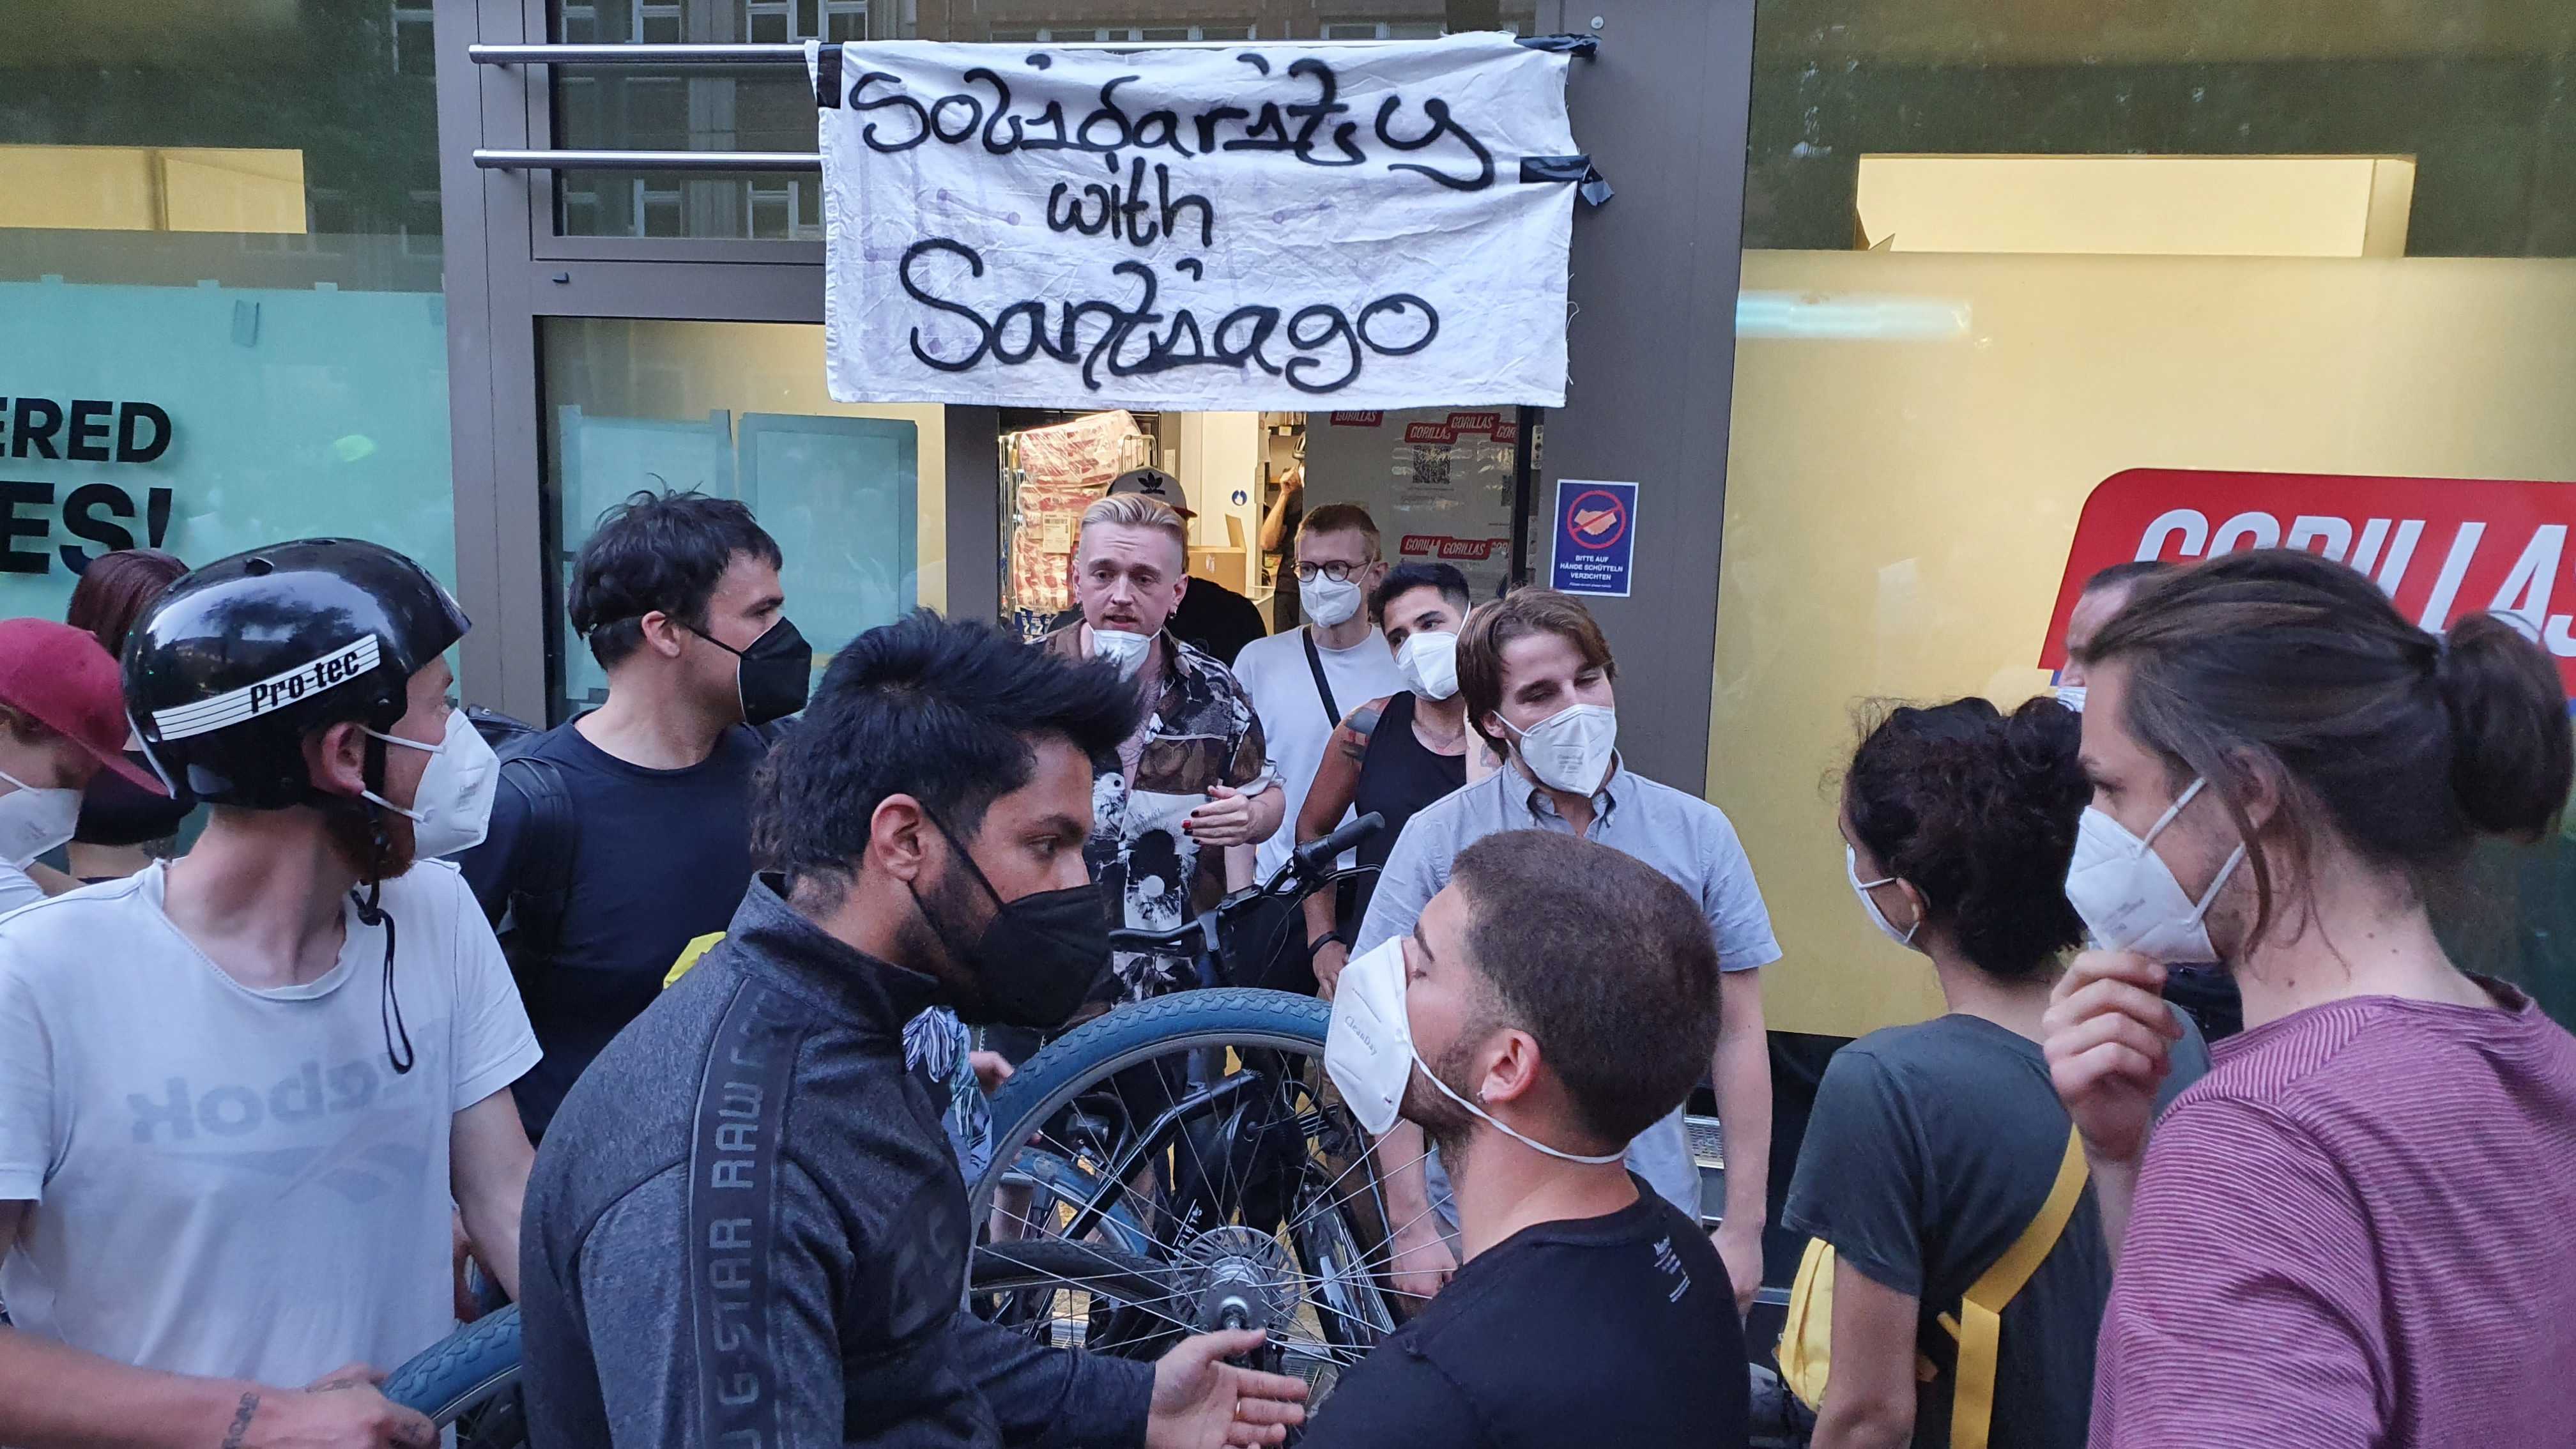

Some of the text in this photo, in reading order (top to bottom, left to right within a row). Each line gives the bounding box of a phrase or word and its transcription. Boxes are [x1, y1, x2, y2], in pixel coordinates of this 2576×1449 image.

[1046, 152, 1213, 247] with
[900, 239, 1439, 392] Santiago
[0, 397, 171, 463] RED
[1451, 416, 1494, 429] GORILLAS
[1443, 542, 1486, 556] GORILLAS
[1584, 564, 1623, 572] SCHÜTTELN
[250, 651, 360, 714] Pro-tec
[711, 1081, 763, 1189] RAW
